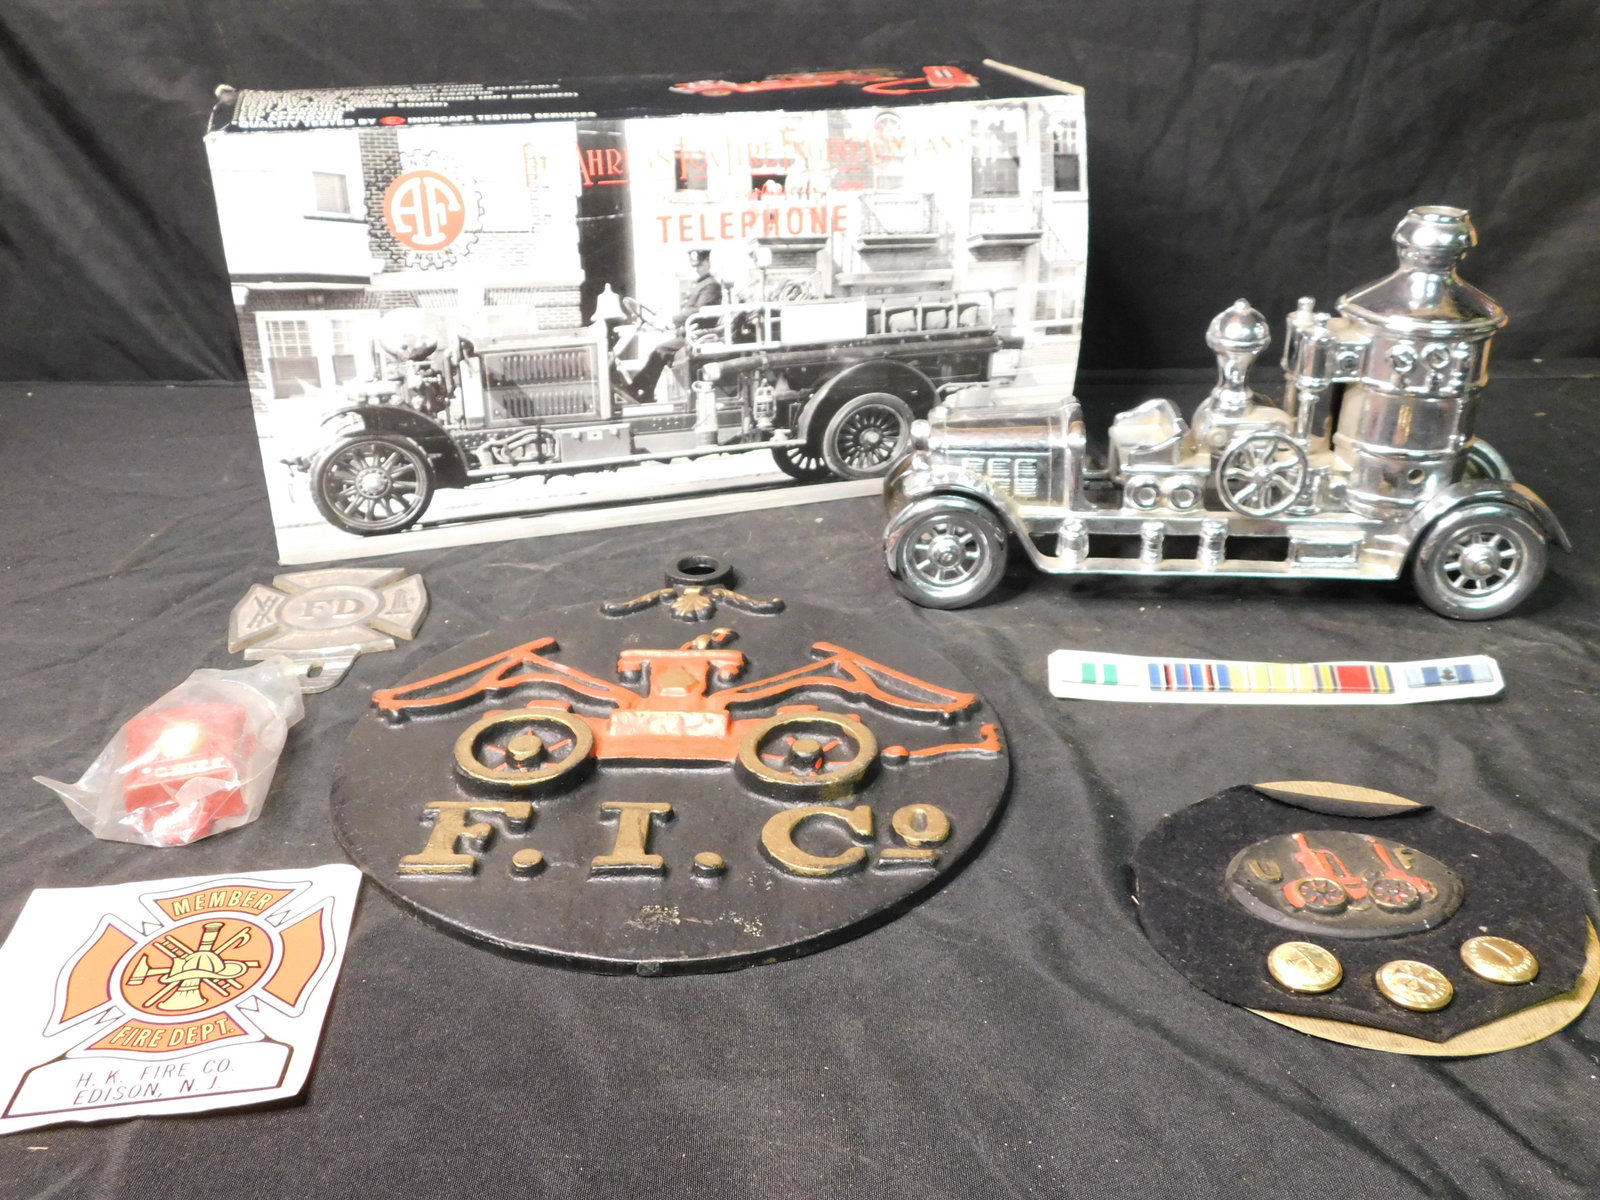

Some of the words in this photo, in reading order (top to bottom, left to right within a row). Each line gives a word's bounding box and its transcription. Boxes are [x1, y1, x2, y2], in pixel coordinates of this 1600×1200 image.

[238, 120, 300, 129] QUALITY
[304, 118, 356, 127] TESTED
[407, 115, 474, 124] INCHCAPE
[476, 113, 532, 121] TESTING
[534, 111, 598, 119] SERVICES
[656, 204, 848, 243] TELEPHONE
[172, 890, 274, 917] MEMBER
[111, 1025, 166, 1049] FIRE
[167, 1017, 237, 1048] DEPT.
[76, 1071, 98, 1089] H.
[105, 1069, 123, 1086] K.
[140, 1062, 191, 1080] FIRE
[202, 1057, 236, 1075] CO.
[72, 1082, 164, 1107] EDISON,
[179, 1078, 202, 1093] N.
